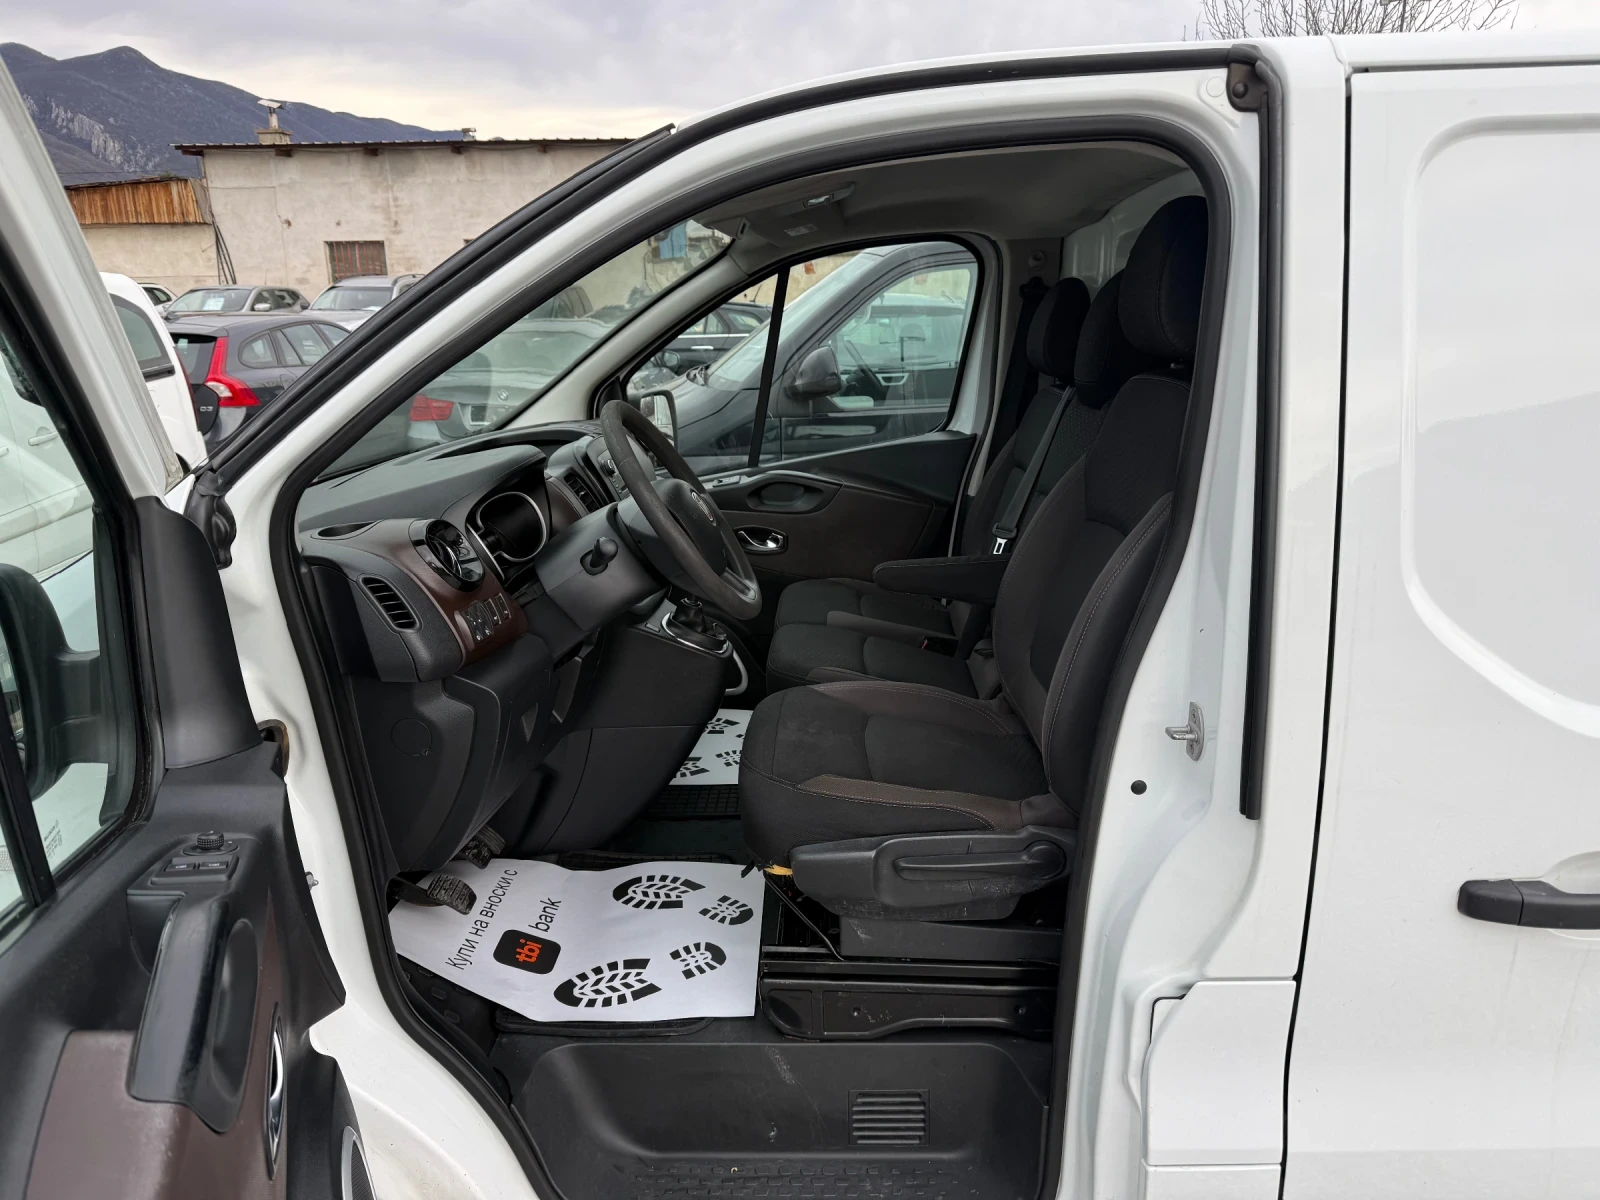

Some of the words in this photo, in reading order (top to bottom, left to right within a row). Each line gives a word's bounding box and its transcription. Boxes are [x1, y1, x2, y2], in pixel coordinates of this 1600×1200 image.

[445, 938, 479, 970] Купи
[468, 919, 490, 937] на
[479, 876, 514, 918] вноски
[528, 897, 562, 933] bank
[515, 938, 542, 963] tbi
